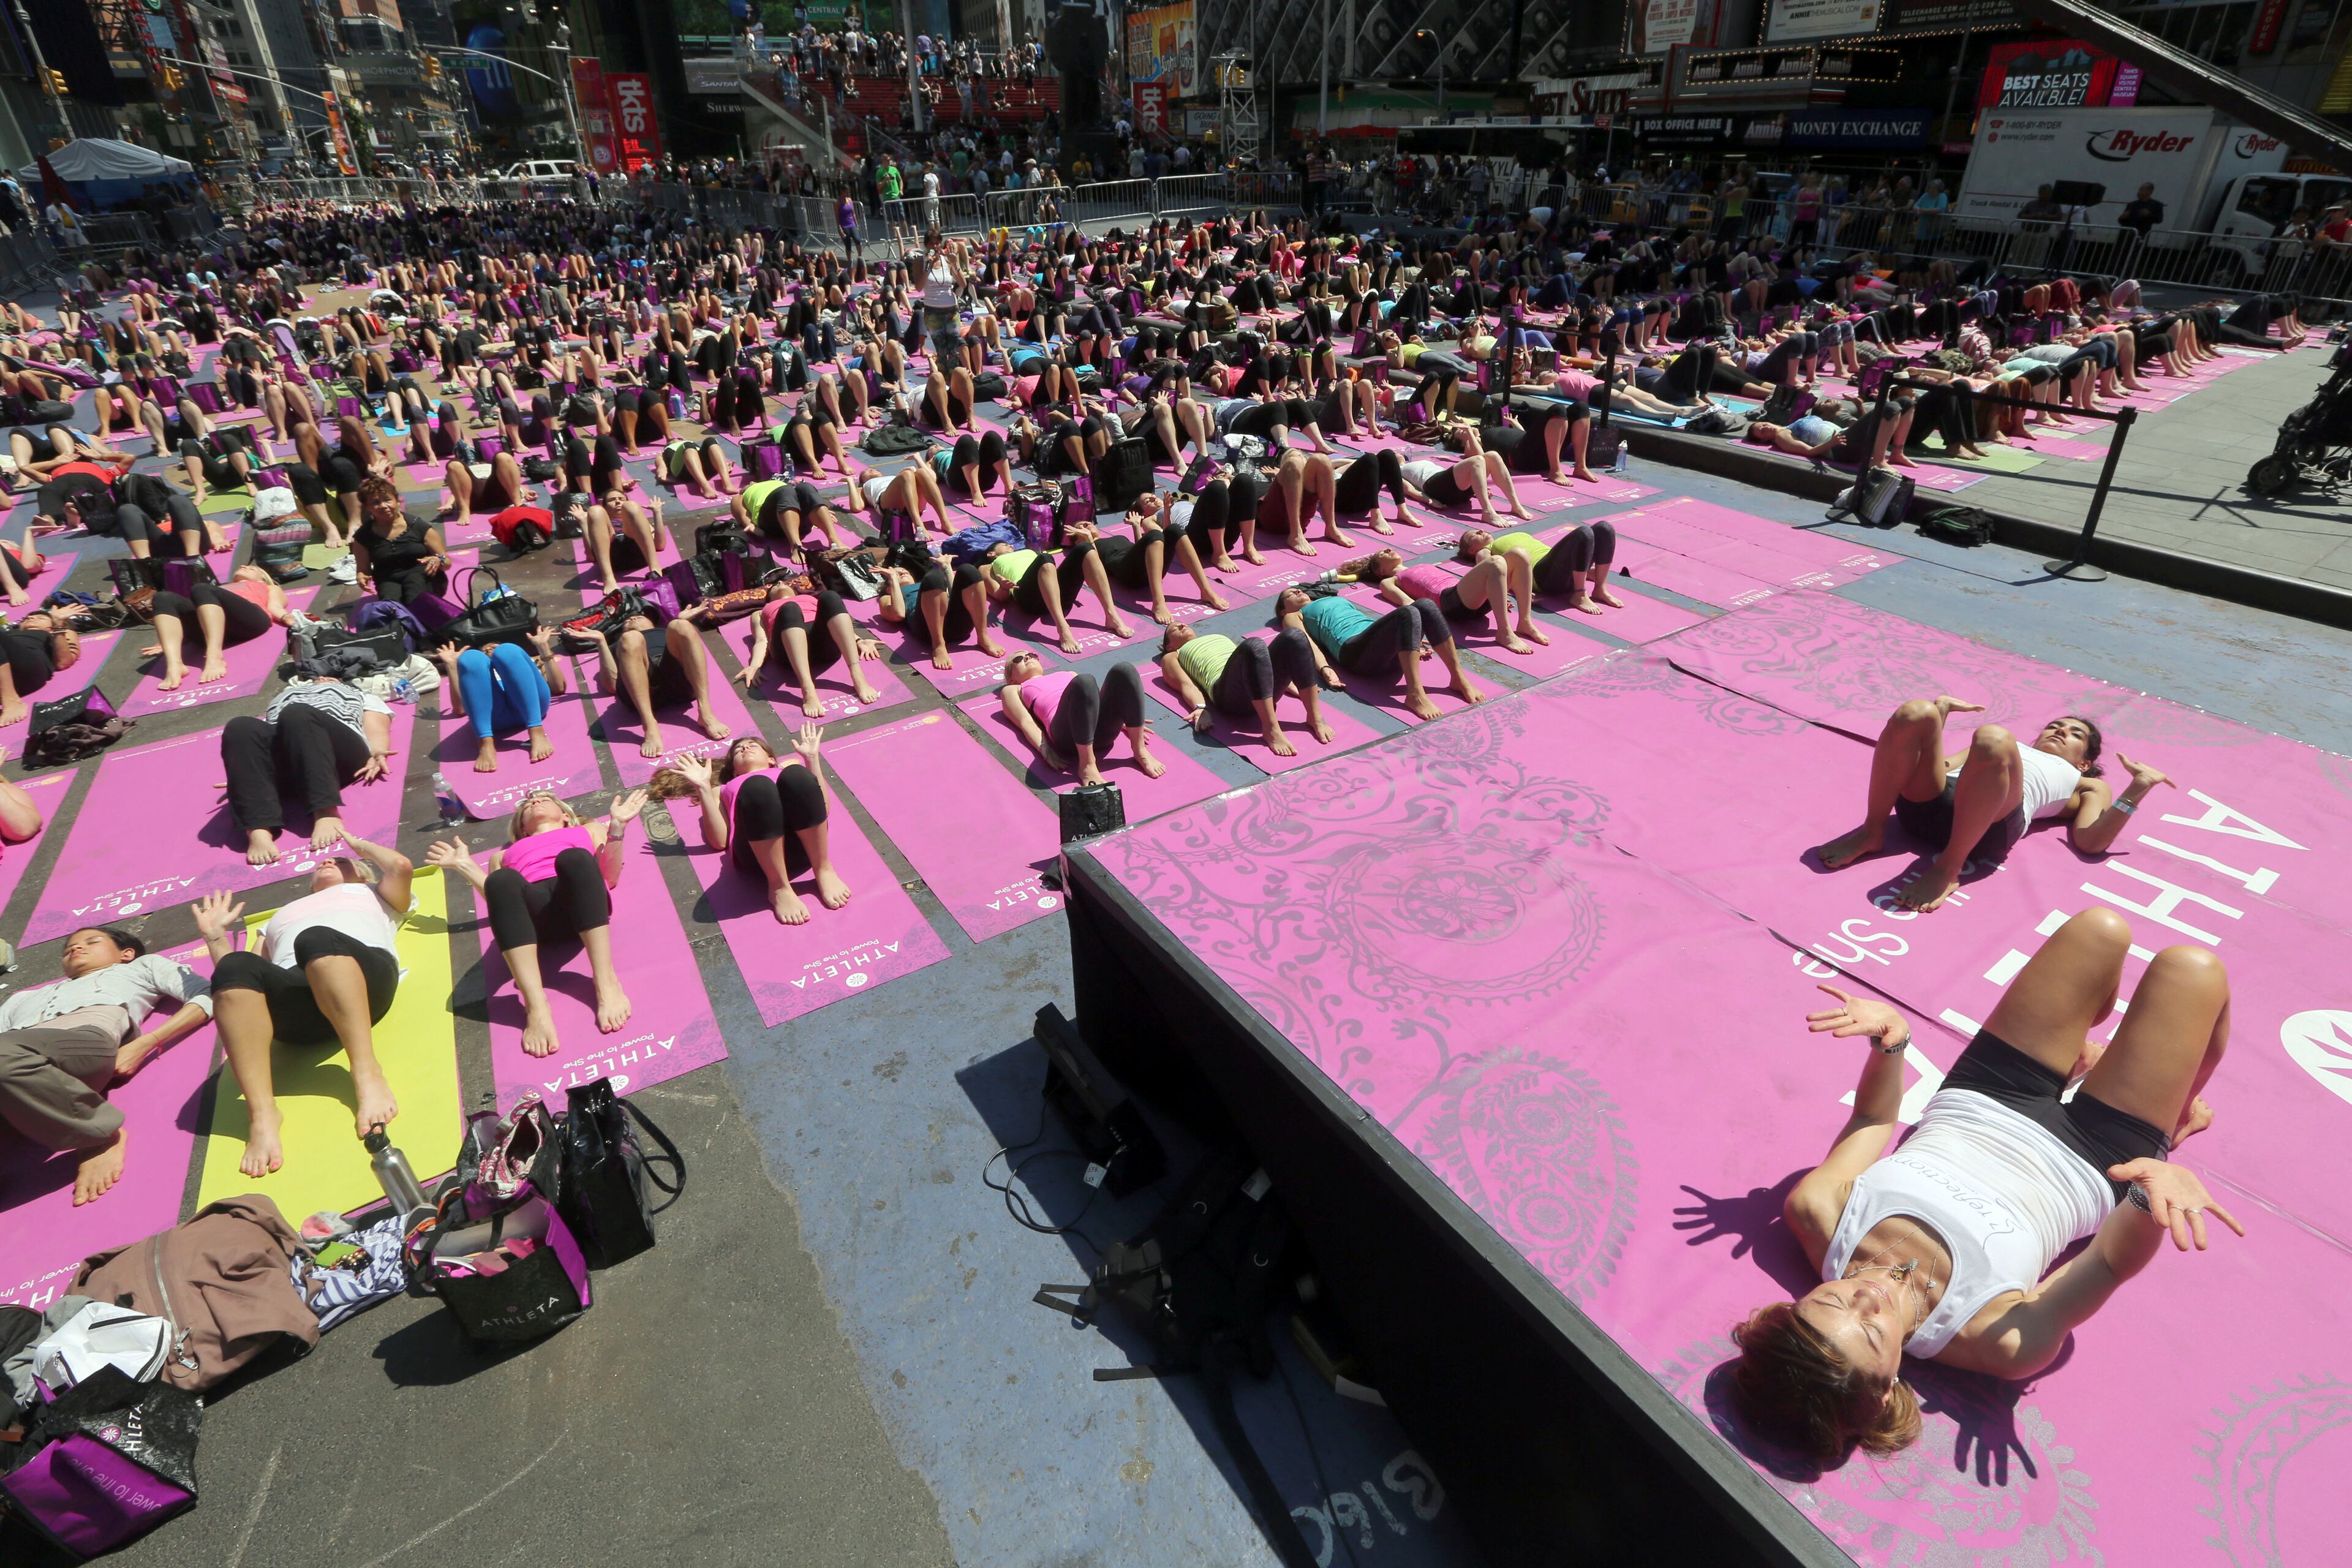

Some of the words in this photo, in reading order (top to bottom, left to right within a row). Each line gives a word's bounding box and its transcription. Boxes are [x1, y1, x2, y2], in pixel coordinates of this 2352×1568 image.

[1789, 6, 1860, 19] ANNIETHEMUSICAL.COM
[1901, 5, 1958, 17] TELECHARGE.COM
[1130, 23, 1151, 42] HEAD
[1692, 63, 1722, 80] Annie
[1733, 61, 1764, 77] Annie
[1777, 58, 1809, 75] Annie
[1820, 56, 1852, 74] Annie
[2003, 75, 2041, 90] BEST
[2042, 72, 2090, 89] SEATS
[617, 78, 647, 133] tkts
[1999, 89, 2086, 107] AVAILBLE!
[1141, 86, 1162, 133] tkts
[1644, 120, 1662, 130] BOX
[1666, 119, 1695, 130] OFFICE
[1698, 118, 1722, 129] HERE
[1744, 120, 1783, 139] Annie
[1792, 122, 1839, 135] MONEY
[1842, 121, 1922, 136] EXCHANGE
[2006, 121, 2062, 129] 1-800-BY-RYDER
[2001, 133, 2055, 141] www.ryder.com
[2109, 130, 2194, 156] Ryder
[2245, 134, 2279, 153] Ryder
[1412, 532, 1455, 546] ATHLETA
[1841, 554, 1877, 567] ATHLETA
[1257, 570, 1306, 587] ATHLETA
[1793, 572, 1833, 586] ATHLETA
[1732, 589, 1774, 606] ATHLETA
[151, 684, 238, 705] ATHLETA
[648, 738, 734, 767] ATHLTA
[530, 776, 554, 786] Power
[473, 777, 569, 807] ATHLETA
[146, 875, 180, 889] Power
[72, 876, 196, 916] ATHLETA
[94, 892, 115, 901] She
[116, 886, 132, 895] the
[994, 886, 1011, 895] She
[850, 938, 880, 952] Power
[1792, 918, 1909, 979] She
[790, 940, 899, 989] ATHLETA
[803, 959, 823, 970] She
[823, 953, 837, 963] the
[620, 1033, 655, 1049] Power
[587, 1051, 605, 1061] the
[607, 1045, 618, 1054] to
[543, 1035, 676, 1093] ATHLETA
[563, 1058, 585, 1069] She
[39, 1261, 81, 1283] ower
[0, 1285, 15, 1298] th
[18, 1278, 35, 1289] to
[481, 1296, 560, 1327] ATHLETA
[92, 1472, 115, 1491] the
[114, 1484, 127, 1497] to
